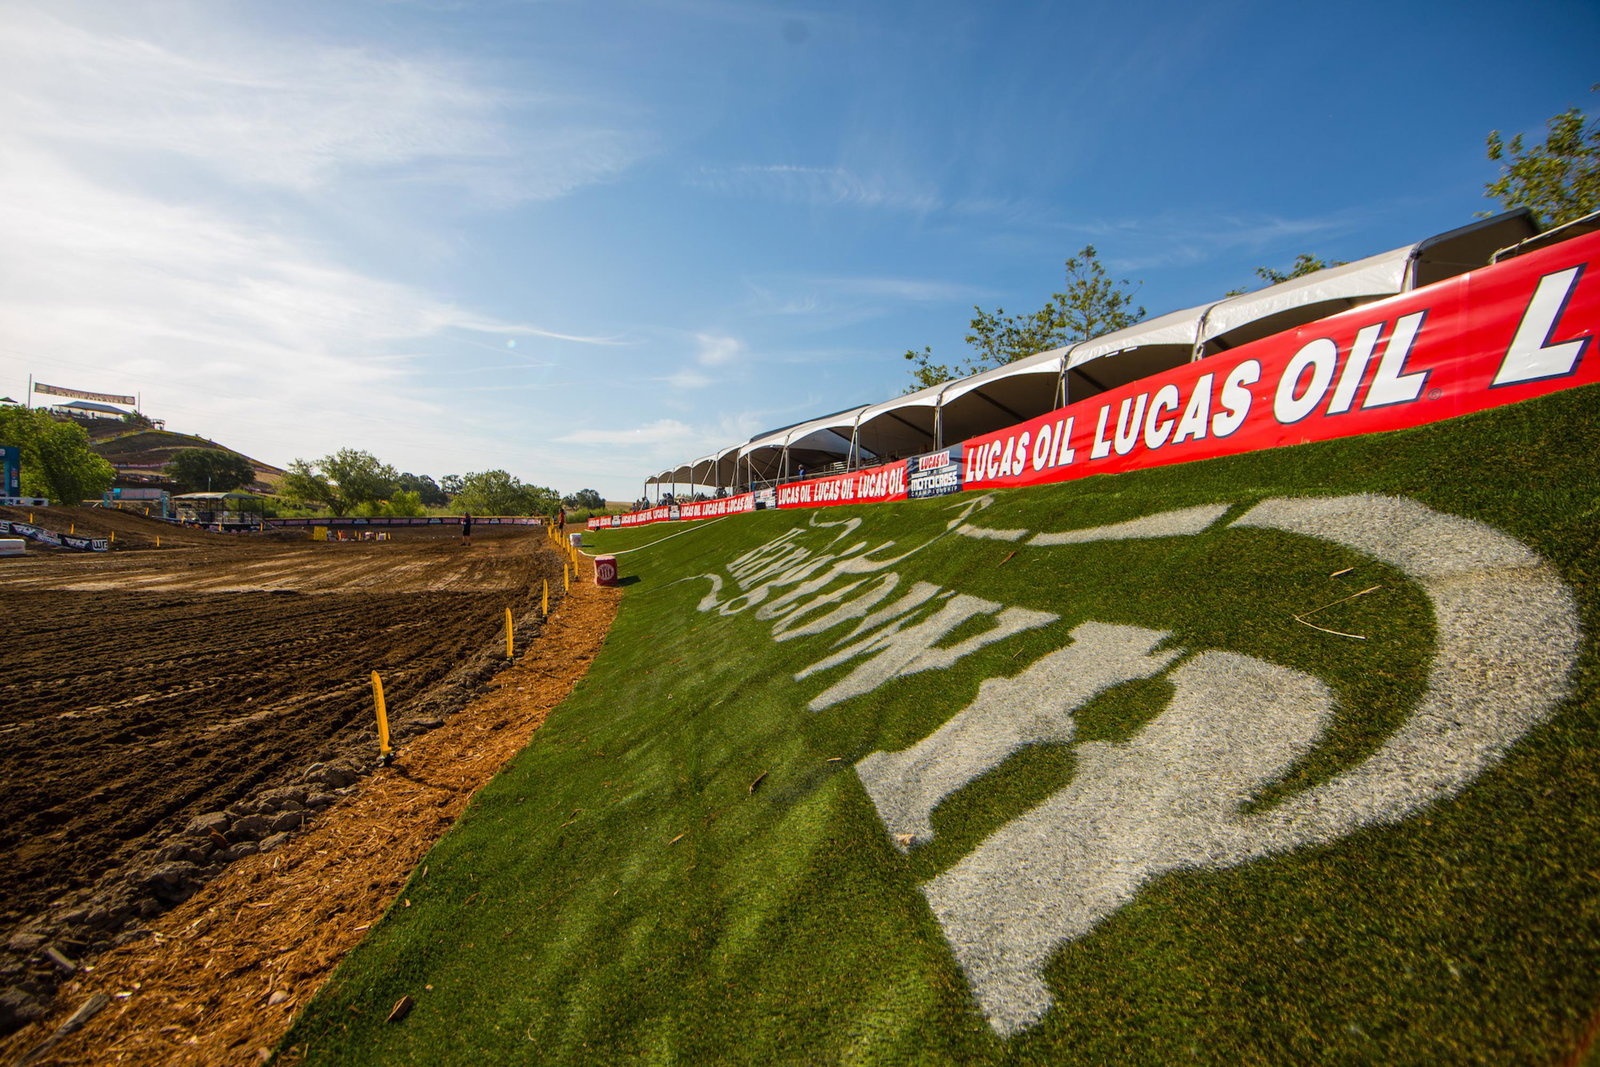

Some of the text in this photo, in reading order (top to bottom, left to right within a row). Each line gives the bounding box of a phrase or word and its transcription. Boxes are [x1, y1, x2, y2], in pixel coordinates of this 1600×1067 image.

[1488, 262, 1600, 390] L
[1090, 308, 1430, 460] LUCAS OIL
[920, 452, 949, 470] LUCAS OIL
[965, 417, 1076, 483] LUCAS OIL
[813, 478, 855, 502] LUCAS OIL
[857, 466, 905, 498] LUCAS OIL
[911, 470, 958, 492] MOTOCROSS
[727, 496, 745, 513] LUCAS
[778, 485, 800, 505] LUCAS
[800, 484, 812, 502] OIL
[702, 501, 718, 516] LUCAS
